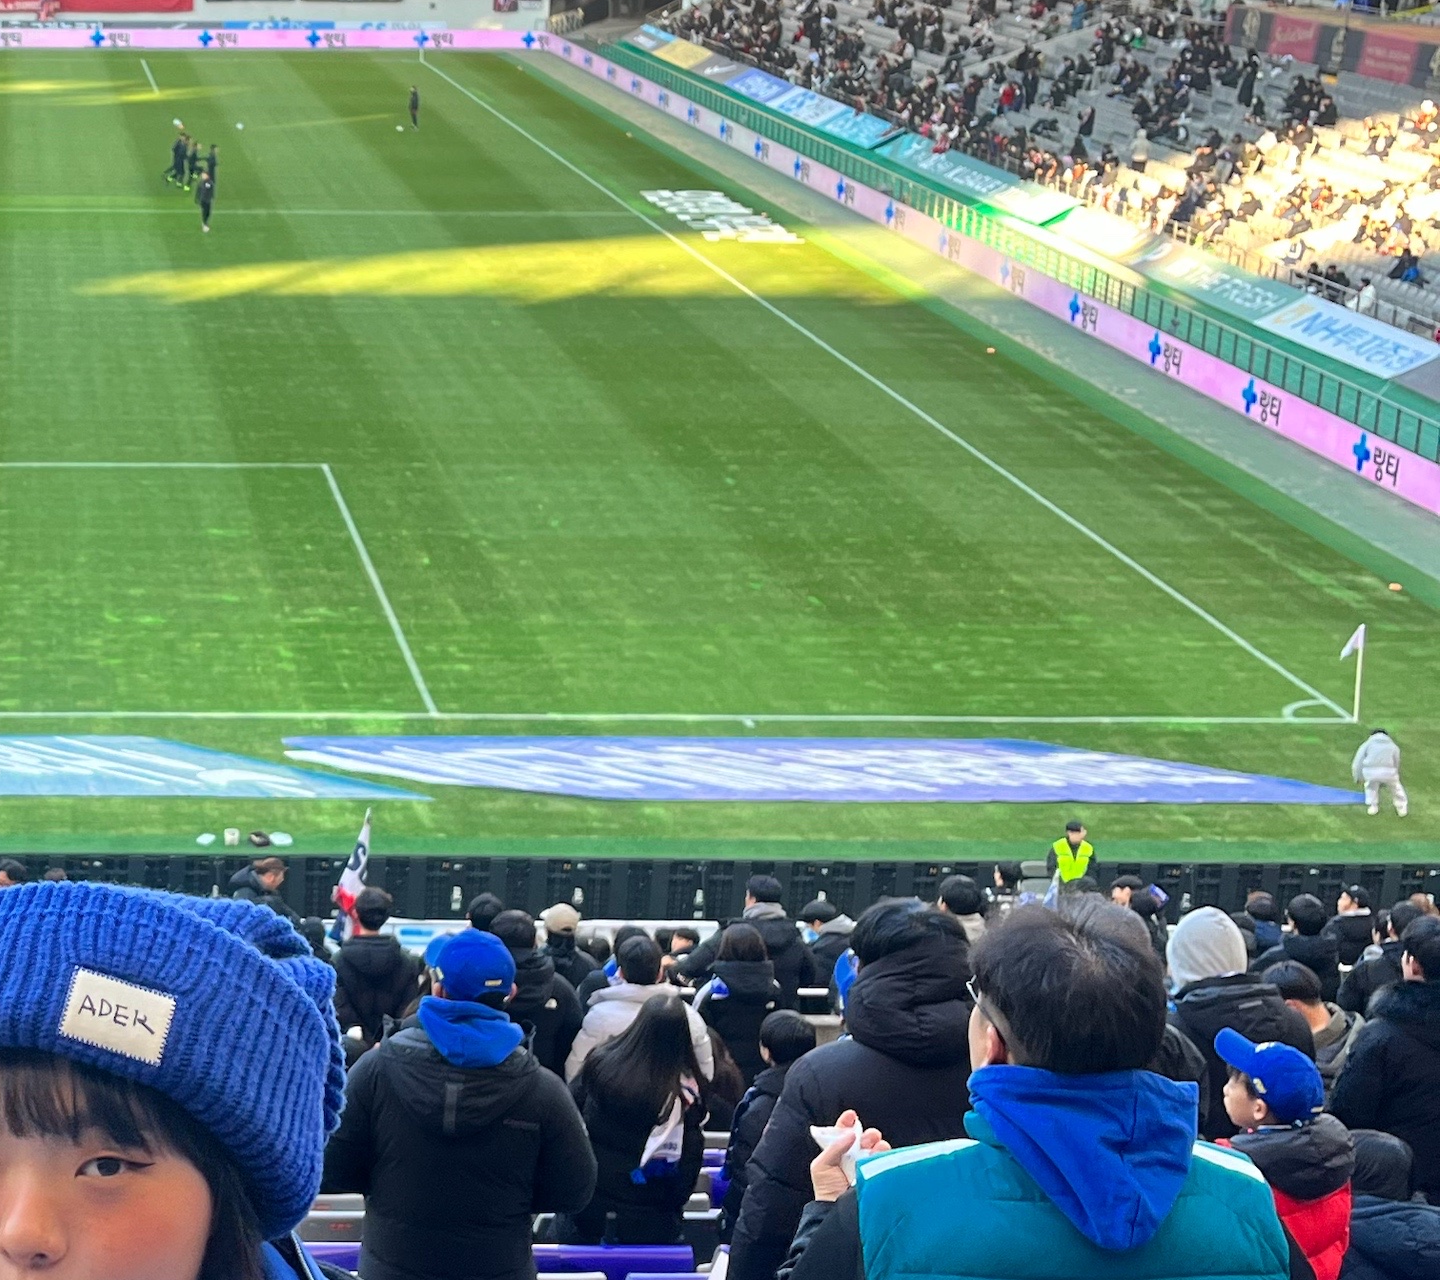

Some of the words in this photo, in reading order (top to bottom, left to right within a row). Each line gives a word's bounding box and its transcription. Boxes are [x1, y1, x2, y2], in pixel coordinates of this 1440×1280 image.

[1163, 342, 1183, 375] 링티
[1260, 390, 1282, 427] 링티
[1373, 446, 1400, 487] 링티
